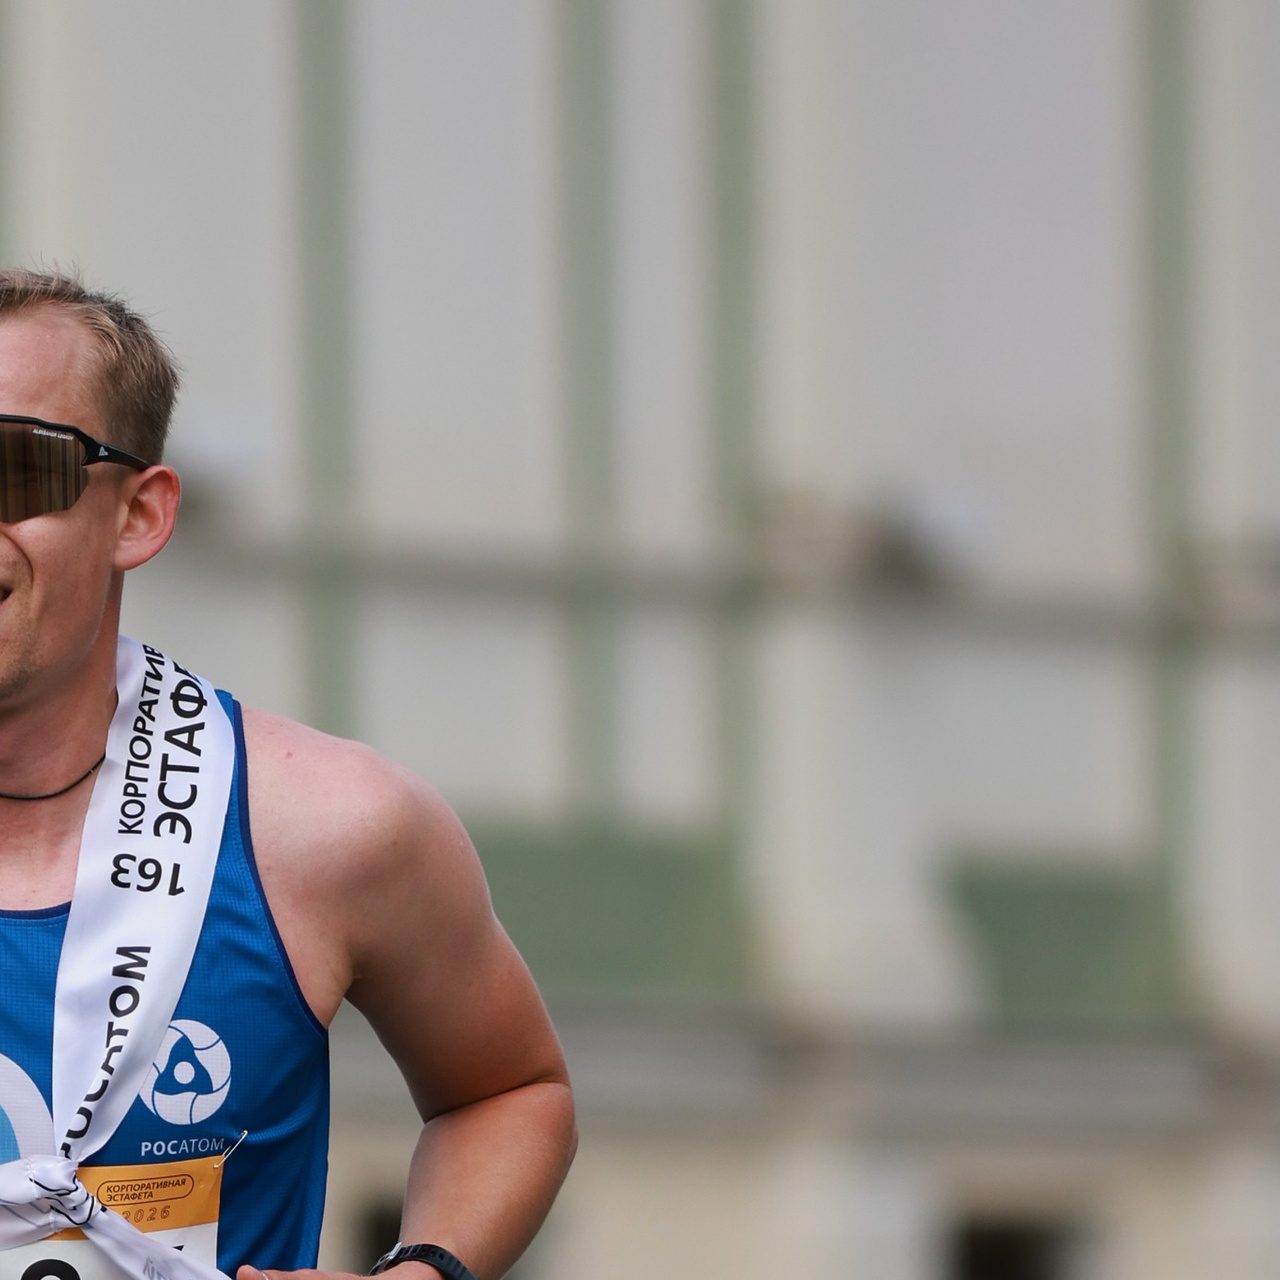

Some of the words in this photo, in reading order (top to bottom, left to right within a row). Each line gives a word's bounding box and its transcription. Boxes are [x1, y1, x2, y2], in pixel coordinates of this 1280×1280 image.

[110, 853, 184, 896] 163
[141, 1138, 224, 1156] РОСАТОМ
[106, 1178, 186, 1194] КОРПОРАТИВНАЯ
[106, 1191, 154, 1203] ЭСТАФЕТА
